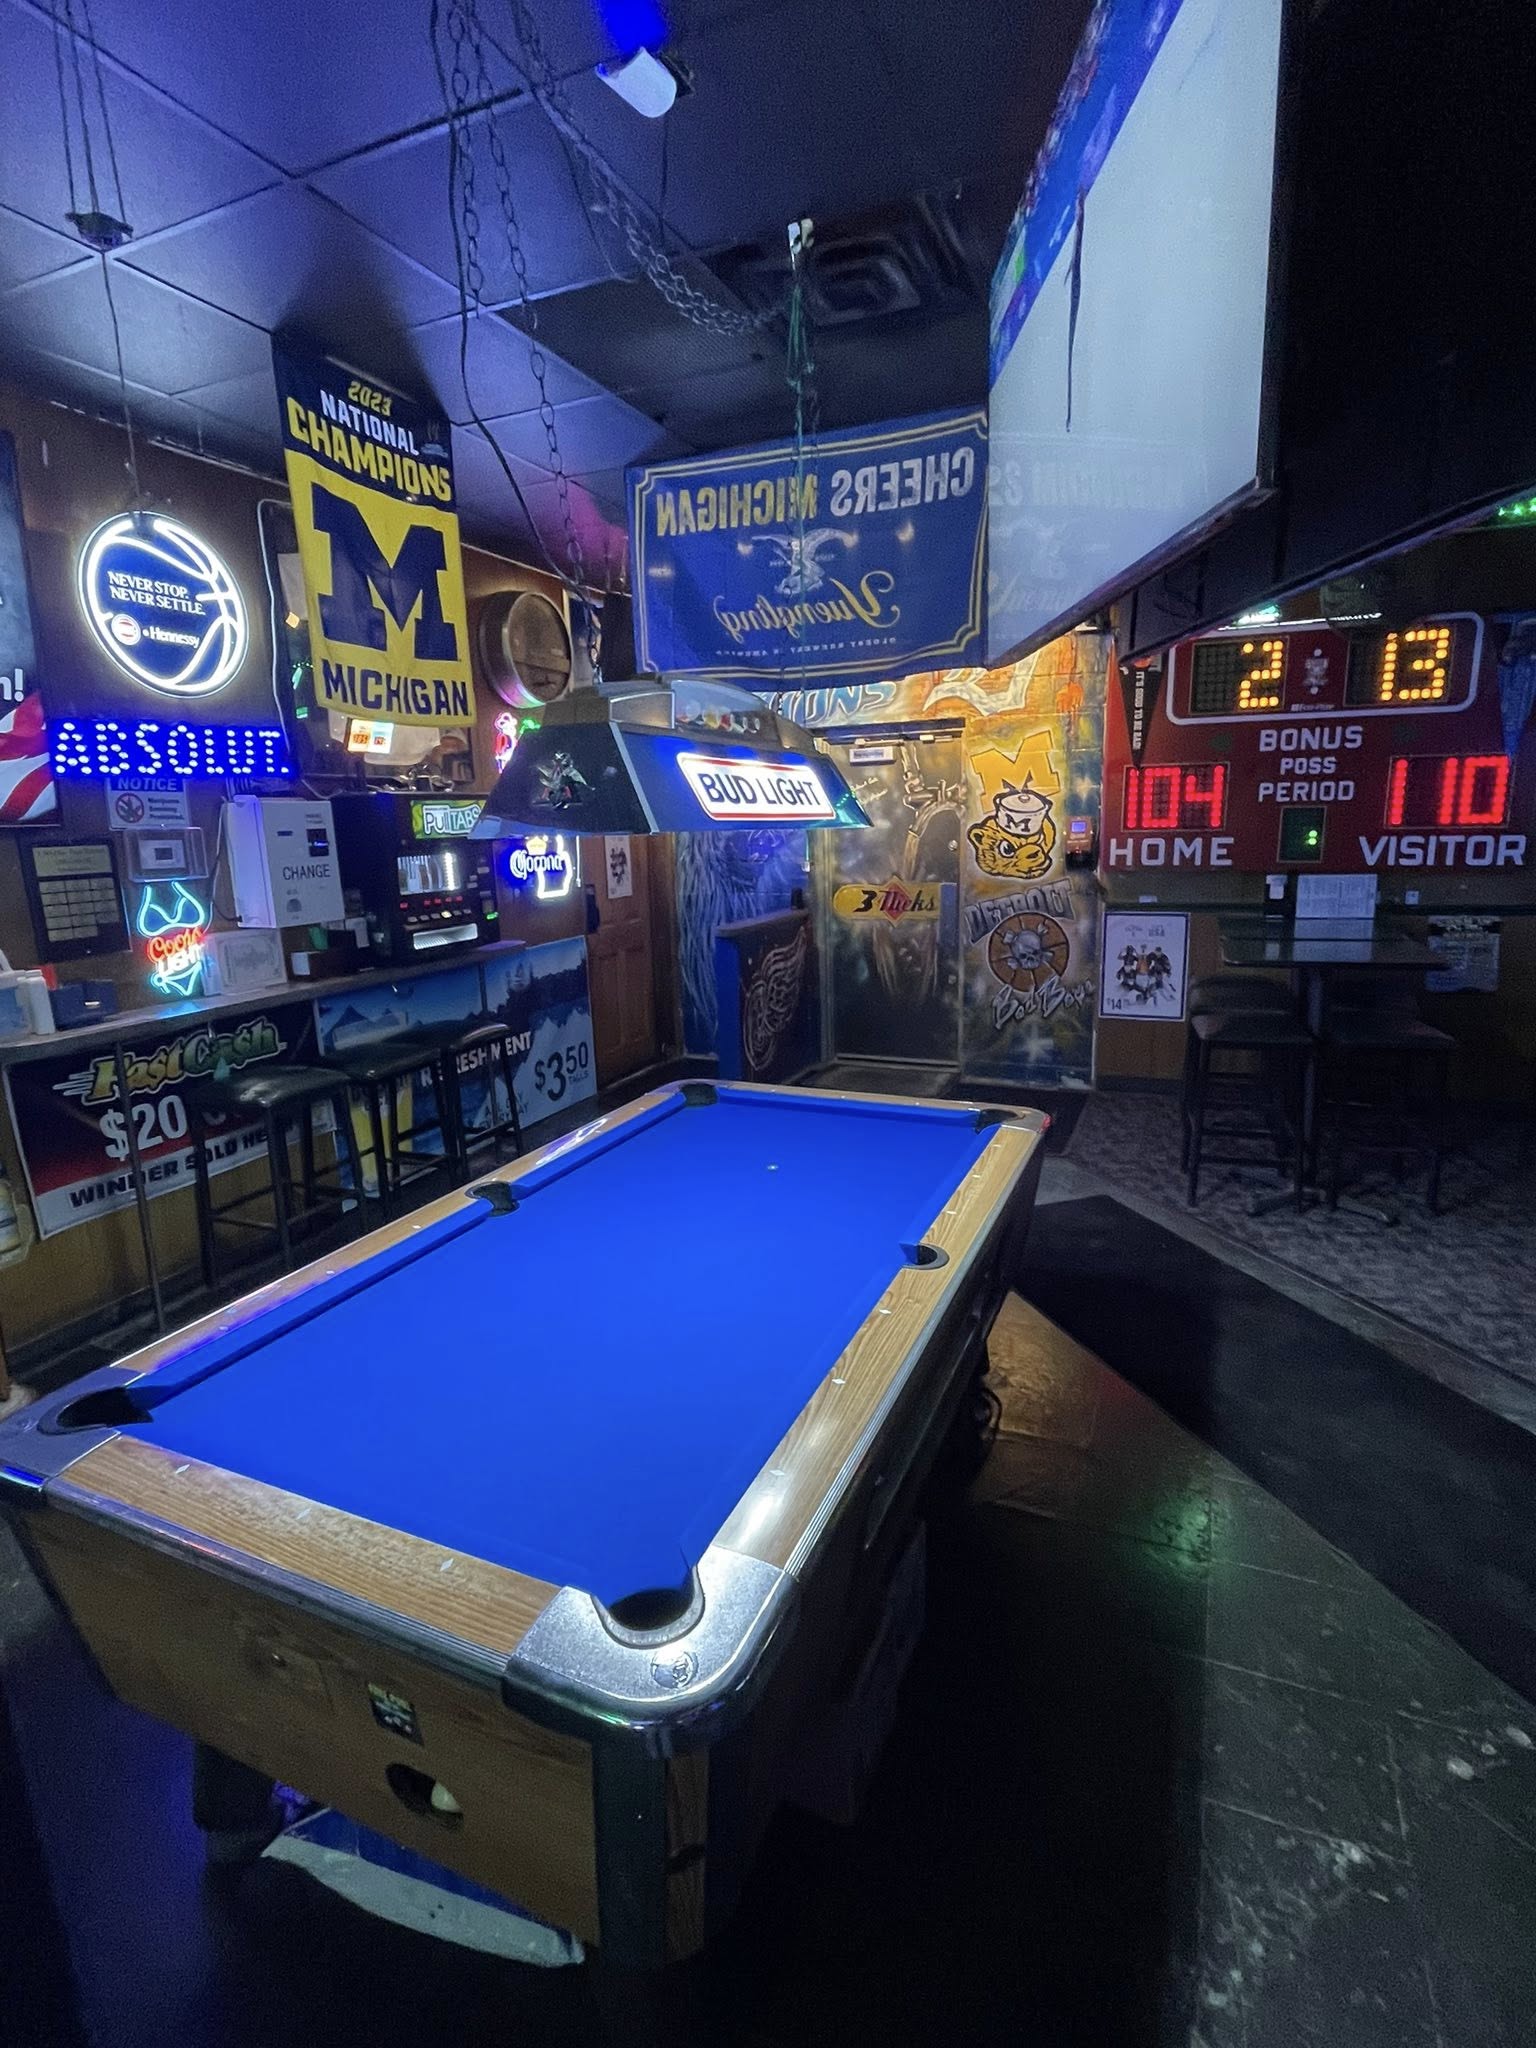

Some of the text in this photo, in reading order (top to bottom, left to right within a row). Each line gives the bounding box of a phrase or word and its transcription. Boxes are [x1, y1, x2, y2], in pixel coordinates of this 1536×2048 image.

[347, 381, 391, 417] 2023
[320, 389, 420, 456] NATIONAL
[286, 396, 452, 502] CHAMPIONS
[107, 571, 189, 599] NEVER STOP.
[311, 482, 460, 662] M
[109, 585, 206, 615] NEVER SETTLE.
[149, 626, 200, 648] Hennessy
[1239, 640, 1284, 709] 2
[1380, 628, 1450, 701] 13
[321, 658, 469, 717] MICHIGAN
[1259, 726, 1364, 753] BONUS
[970, 730, 1060, 814] M
[1280, 757, 1336, 775] POSS
[117, 778, 177, 791] NOTICE
[698, 773, 761, 804] BUD
[765, 776, 822, 807] LIGHT
[1127, 765, 1224, 828] 104
[1259, 780, 1354, 803] PERIOD
[1005, 814, 1032, 832] M
[510, 850, 565, 880] Corona
[1109, 837, 1234, 867] HOME
[1359, 834, 1526, 867] VISITOR
[282, 864, 331, 881] CHANGE
[853, 889, 877, 912] 3
[962, 877, 1076, 944] DETROIT
[147, 926, 204, 962] Coors
[993, 974, 1095, 1030] Bad Boys
[86, 1038, 187, 1101] Fast
[420, 1031, 532, 1088] RESHMENT
[99, 1095, 188, 1162] $20
